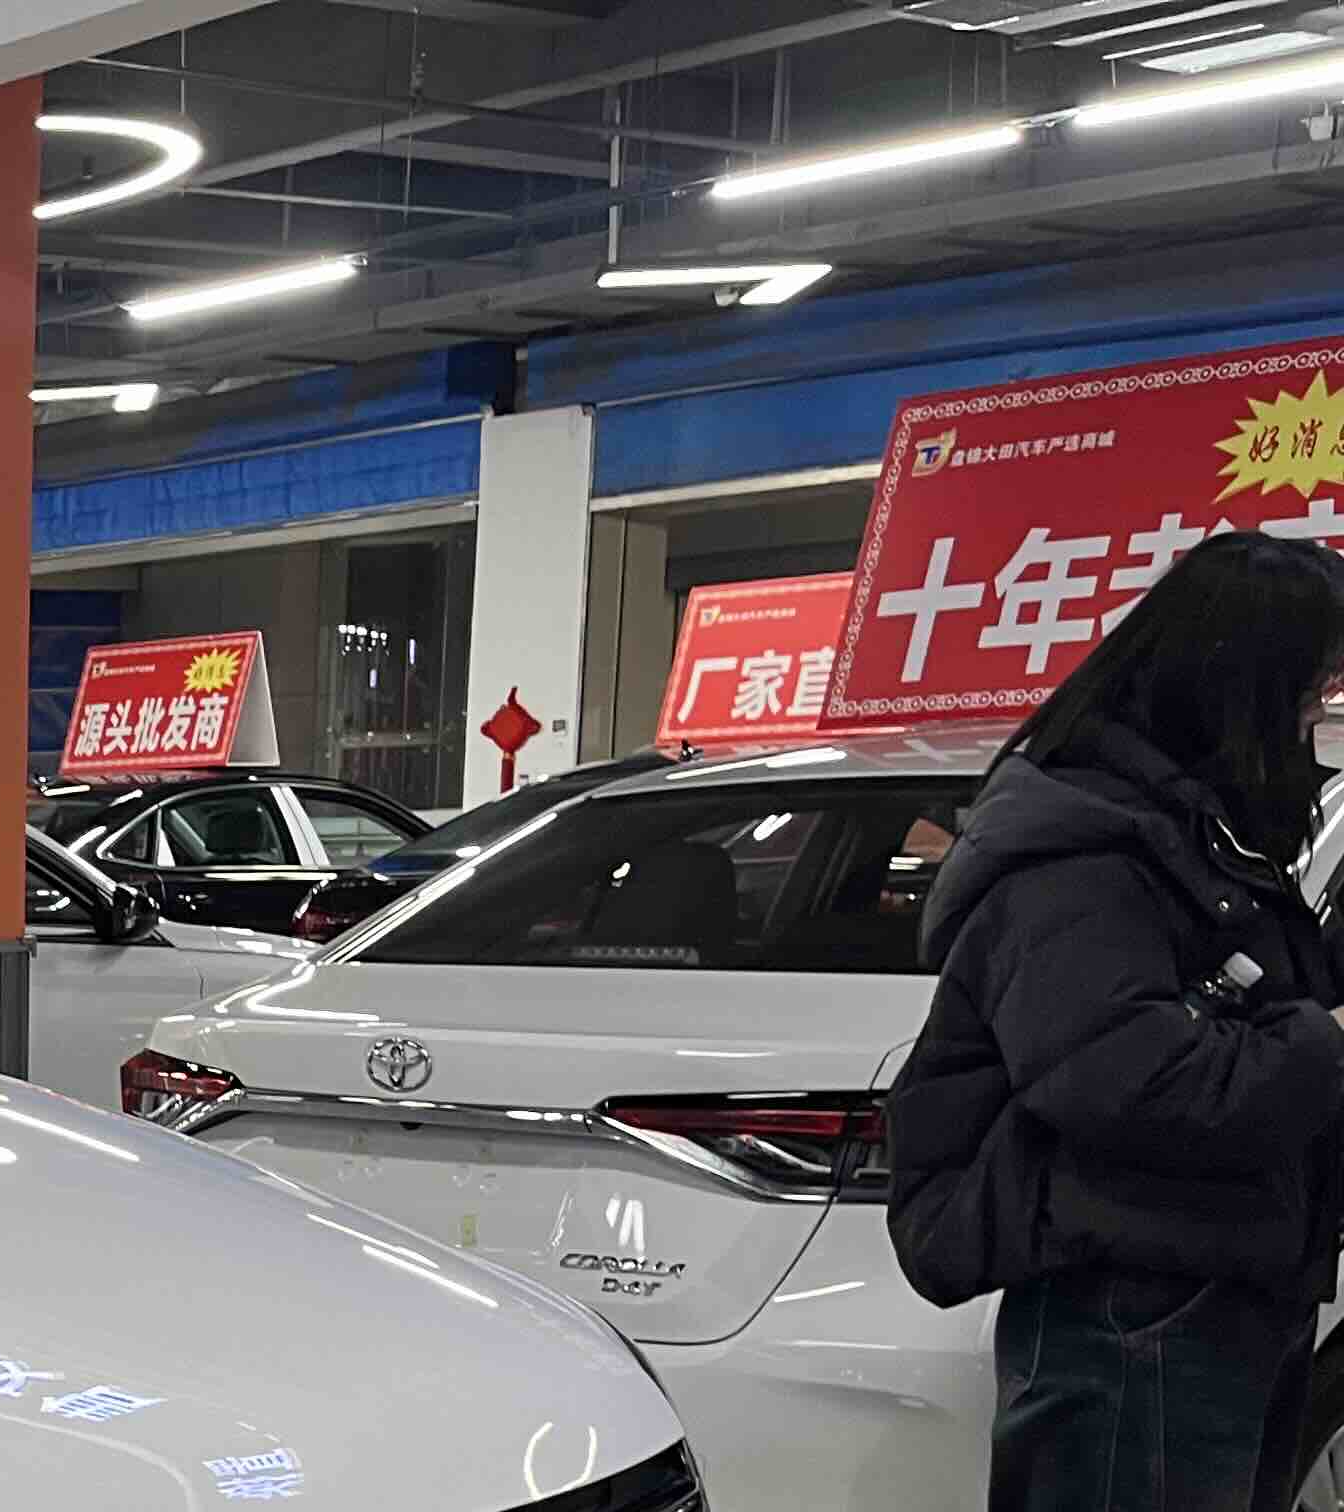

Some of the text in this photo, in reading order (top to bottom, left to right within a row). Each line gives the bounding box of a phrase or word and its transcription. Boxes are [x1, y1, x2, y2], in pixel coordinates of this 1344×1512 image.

[677, 646, 836, 723] 厂家直
[74, 692, 229, 757] 源头批发商
